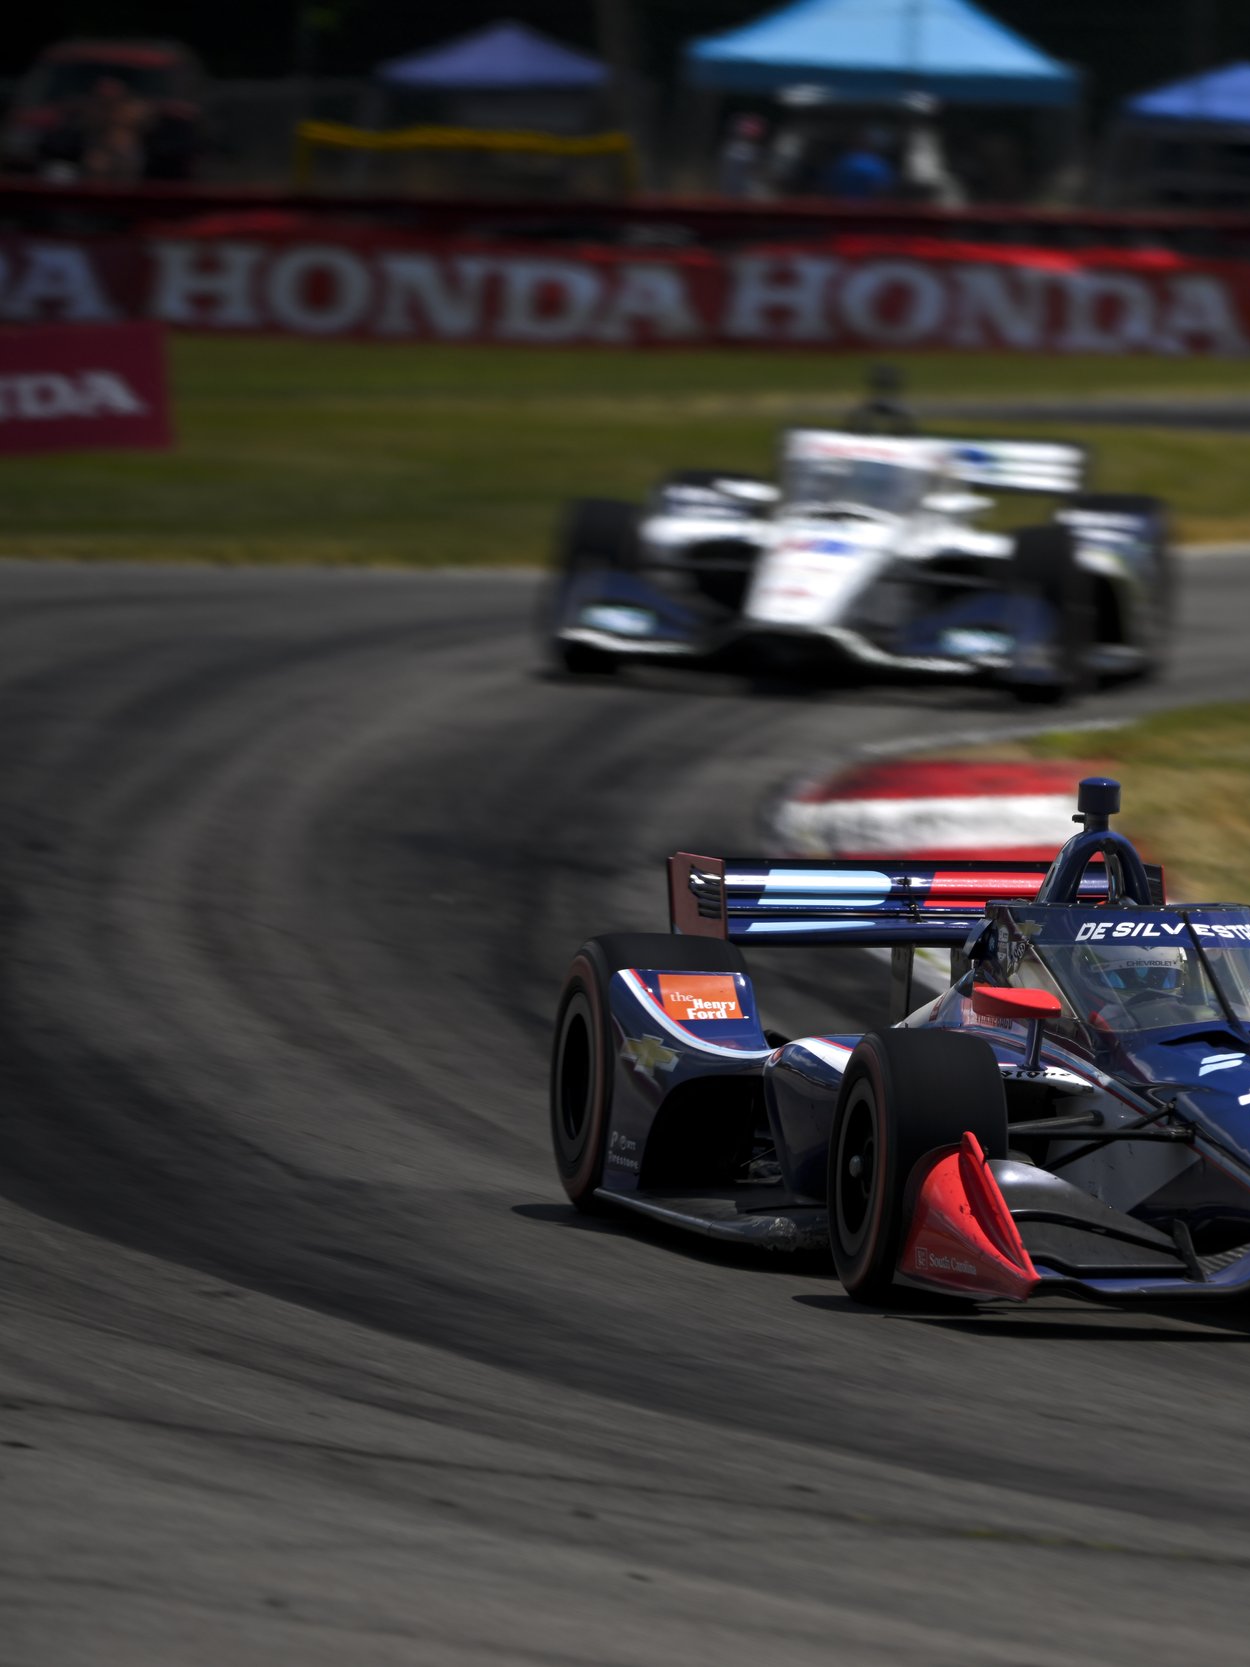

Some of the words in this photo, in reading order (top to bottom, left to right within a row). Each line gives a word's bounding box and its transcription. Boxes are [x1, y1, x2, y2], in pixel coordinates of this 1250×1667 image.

[0, 244, 119, 321] A
[148, 241, 705, 345] HONDA
[0, 368, 149, 420] DA
[670, 992, 693, 1002] the
[692, 999, 736, 1011] Henry
[686, 1008, 728, 1020] Ford
[929, 1253, 950, 1270] South
